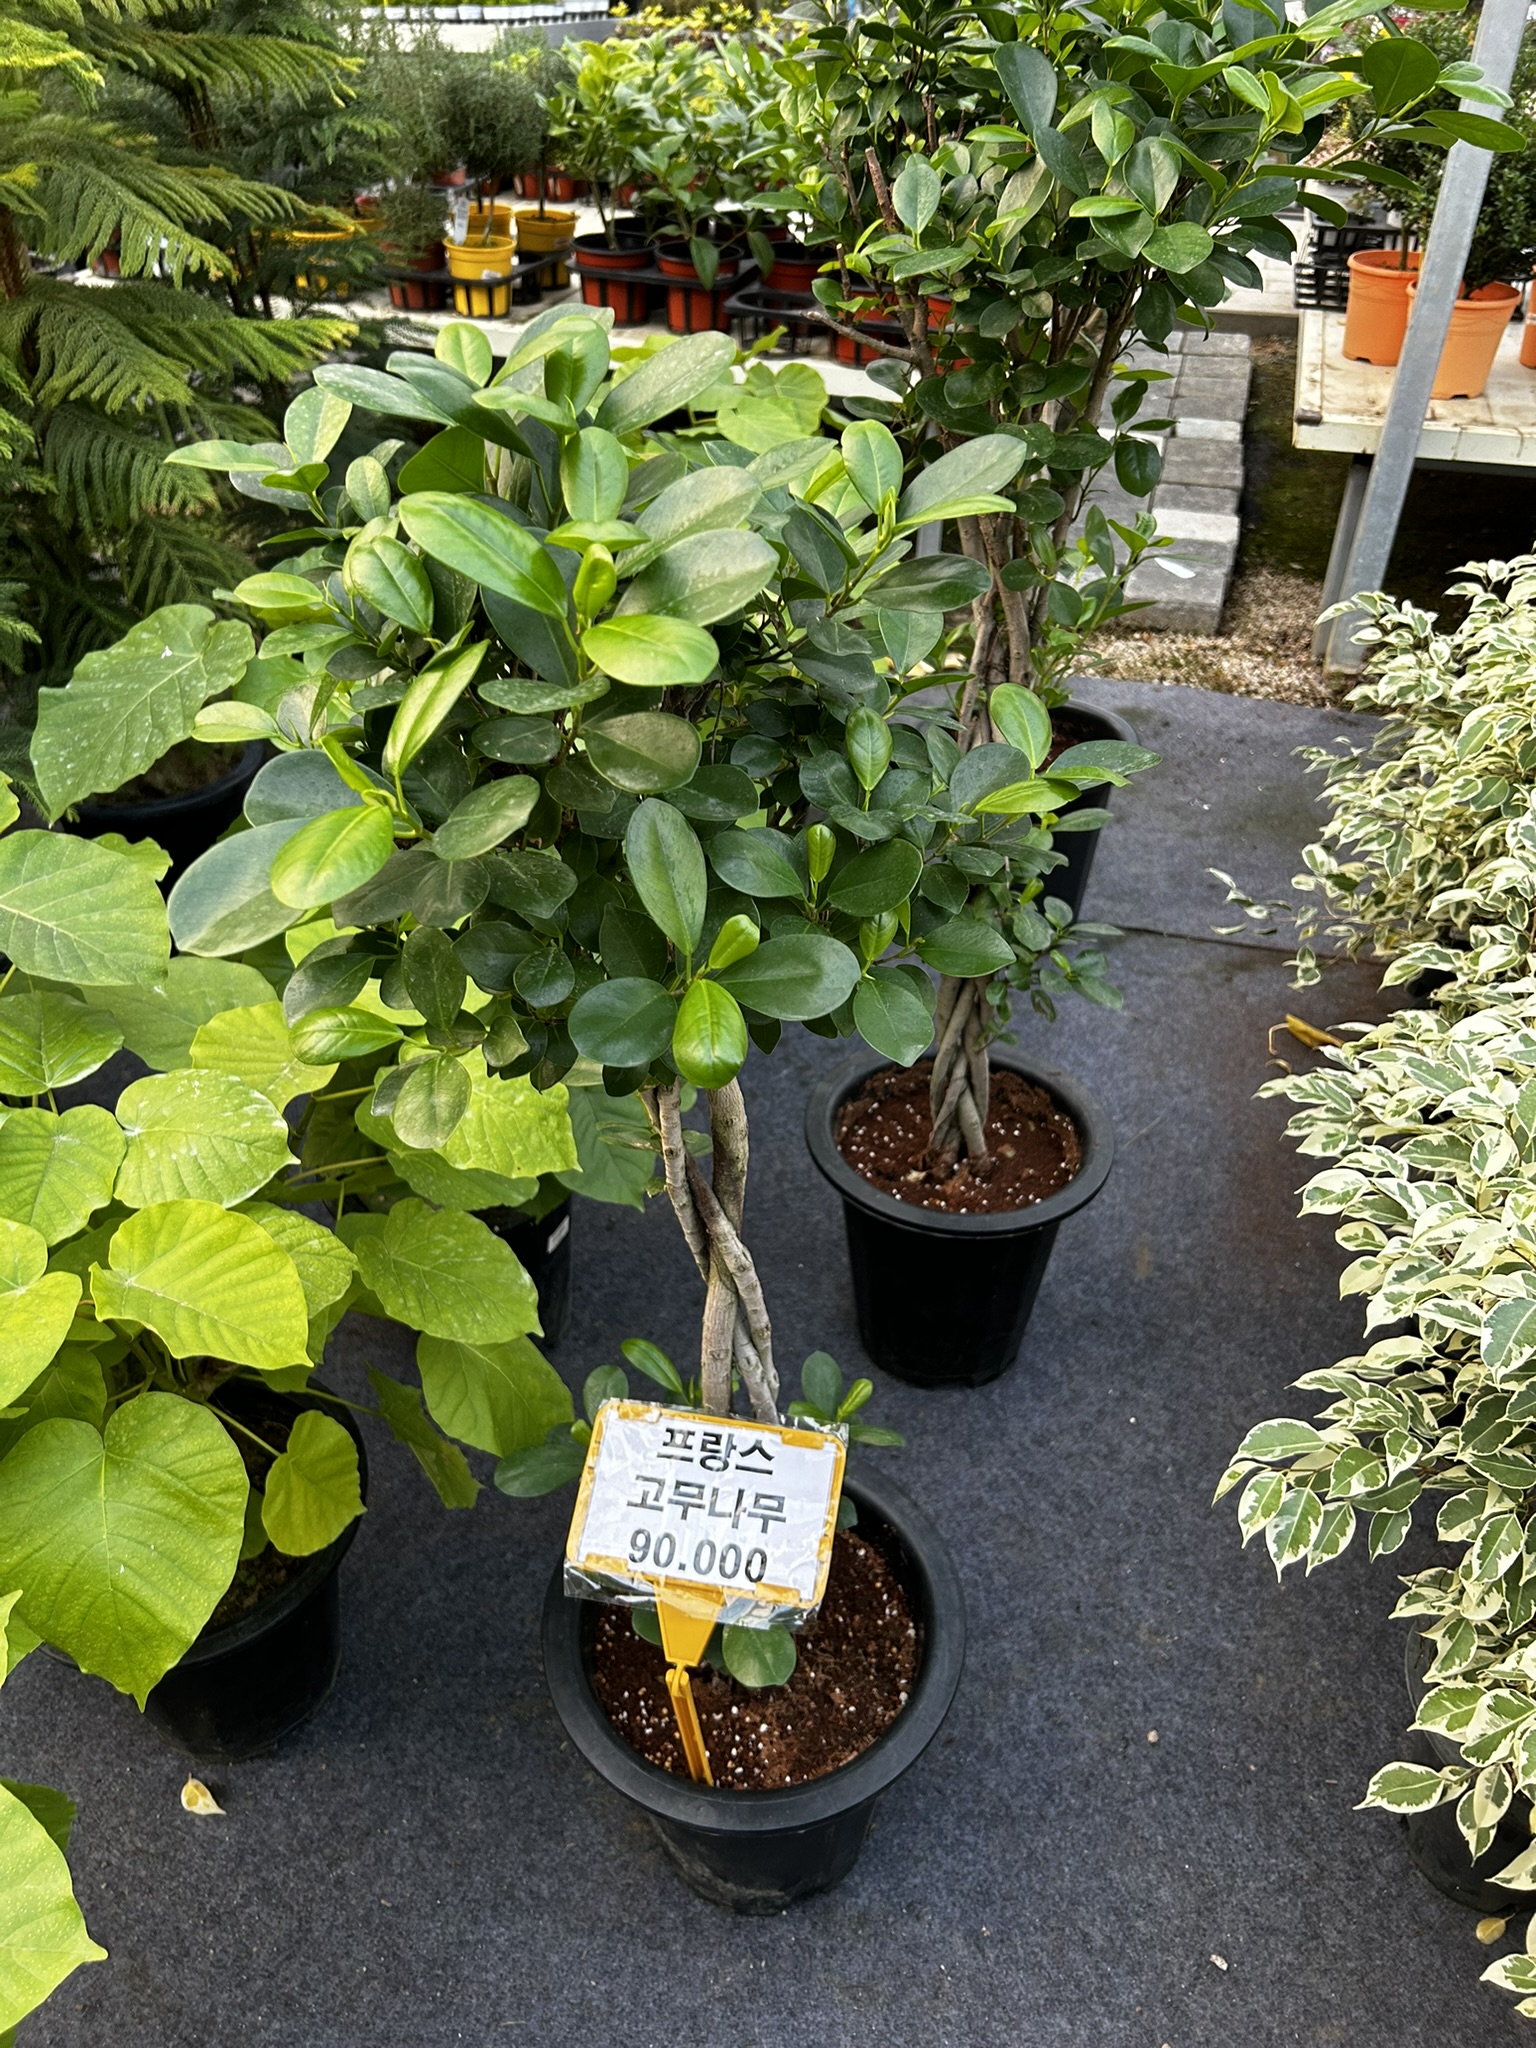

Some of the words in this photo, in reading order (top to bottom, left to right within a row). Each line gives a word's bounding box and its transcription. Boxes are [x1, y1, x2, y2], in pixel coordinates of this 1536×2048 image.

[656, 1428, 774, 1475] 프랑스
[626, 1475, 786, 1534] 고무나무
[628, 1528, 767, 1583] 90.000
